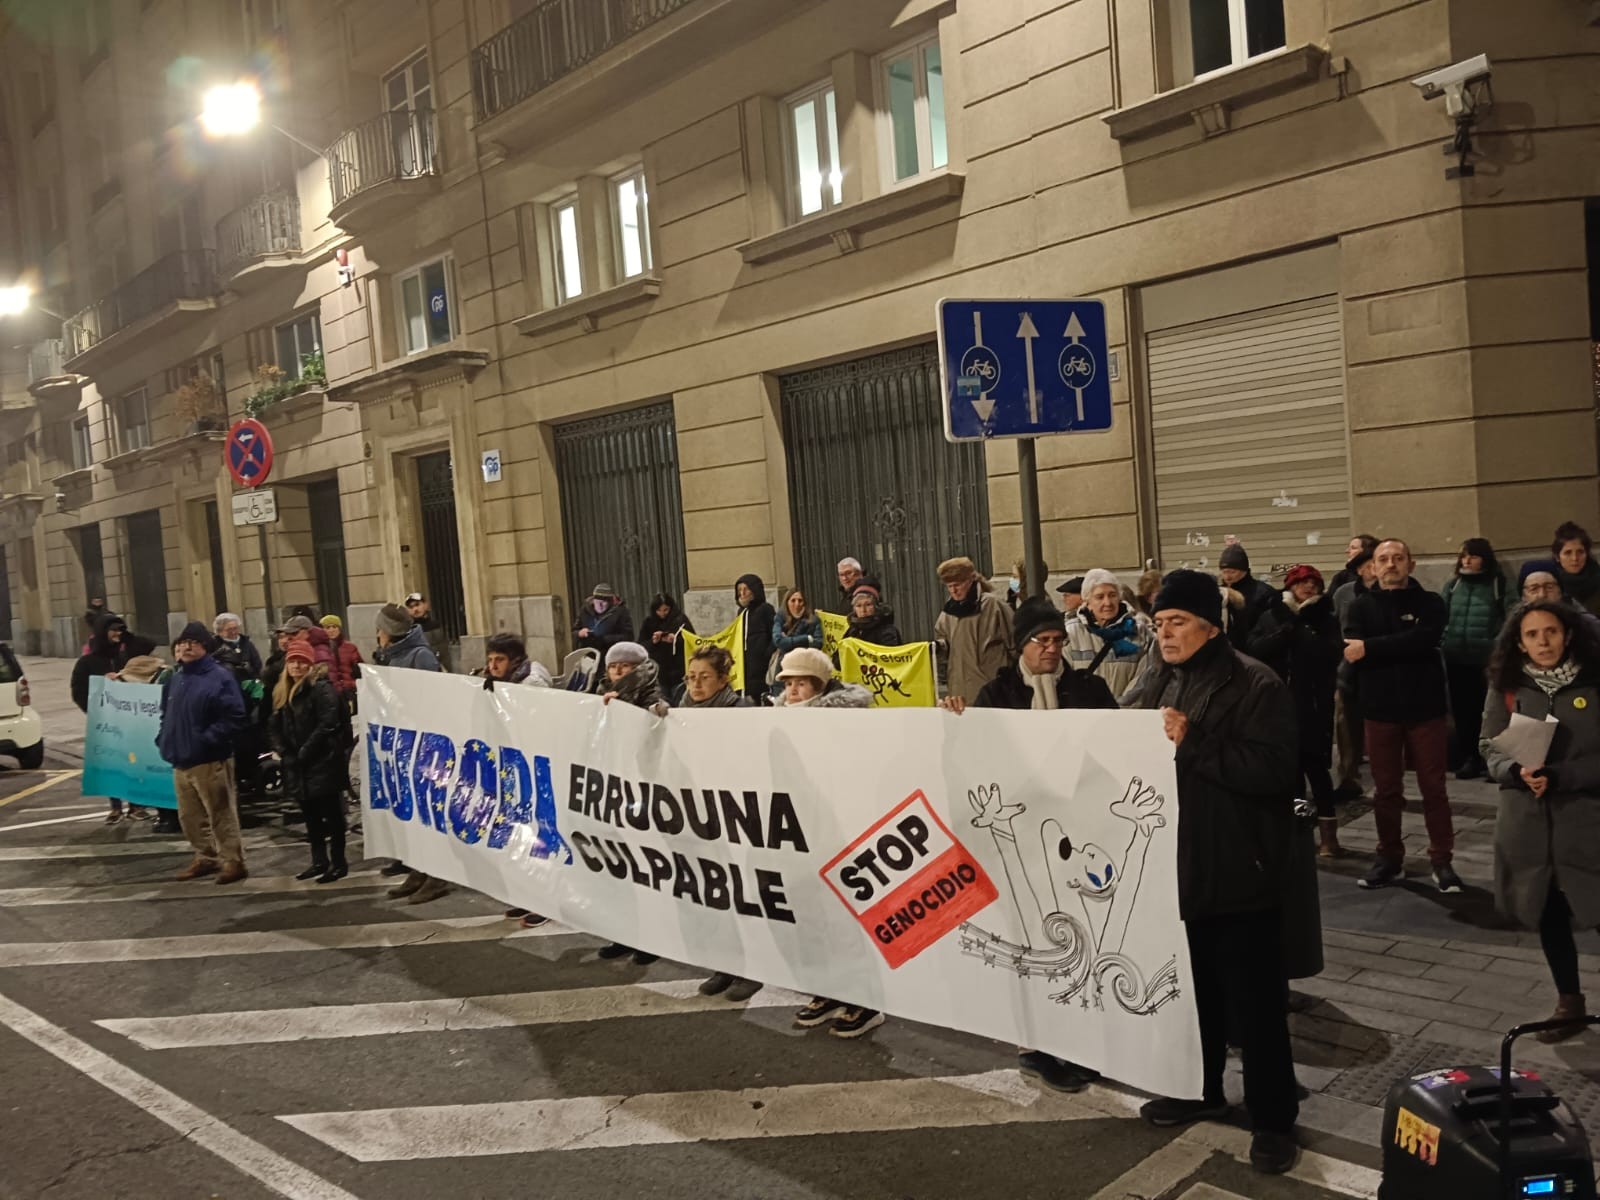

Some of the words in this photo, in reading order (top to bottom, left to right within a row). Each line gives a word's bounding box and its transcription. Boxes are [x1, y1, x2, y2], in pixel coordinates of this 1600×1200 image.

[568, 763, 810, 853] ERRUDUNA
[571, 831, 796, 924] CULPABLE
[840, 815, 929, 902] STOP
[874, 864, 977, 945] GENOCIDIO
